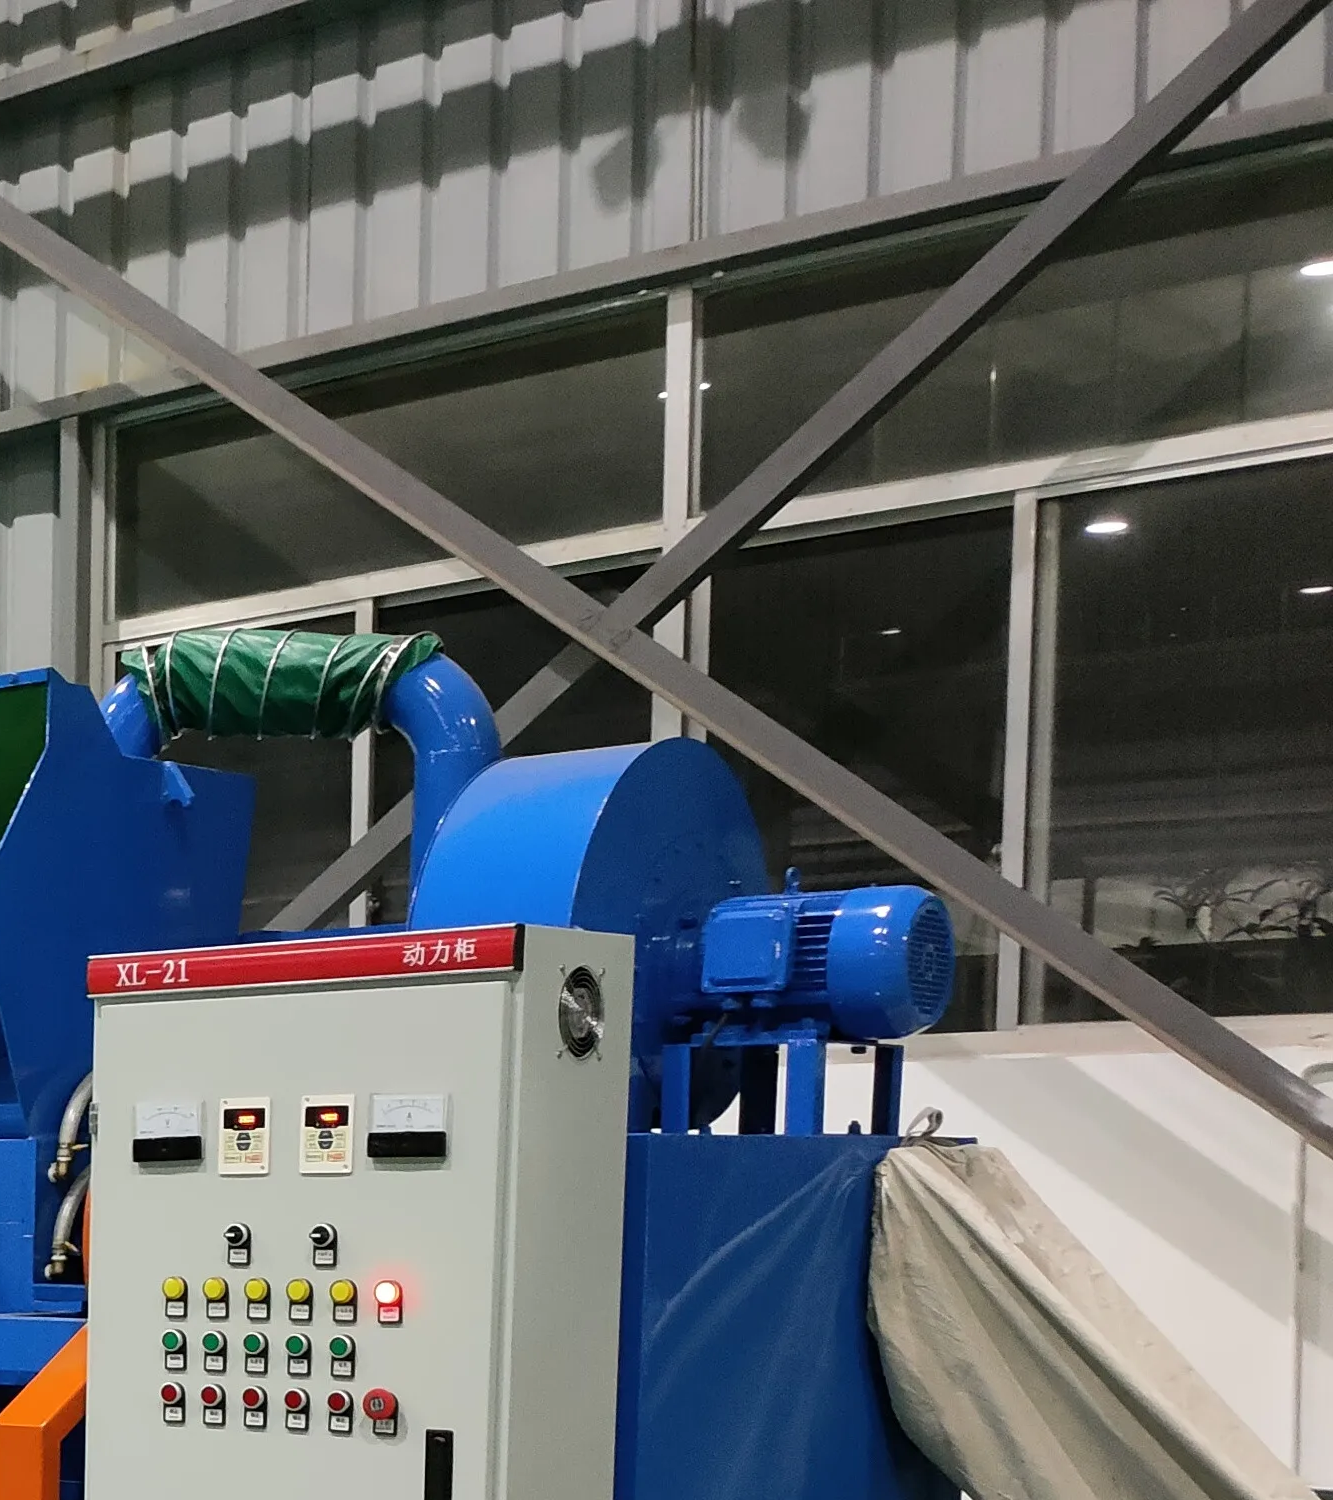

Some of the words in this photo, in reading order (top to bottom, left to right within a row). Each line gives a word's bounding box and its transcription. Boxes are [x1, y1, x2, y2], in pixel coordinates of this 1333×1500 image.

[402, 938, 478, 967] 动力柜
[115, 959, 190, 987] XL-21
